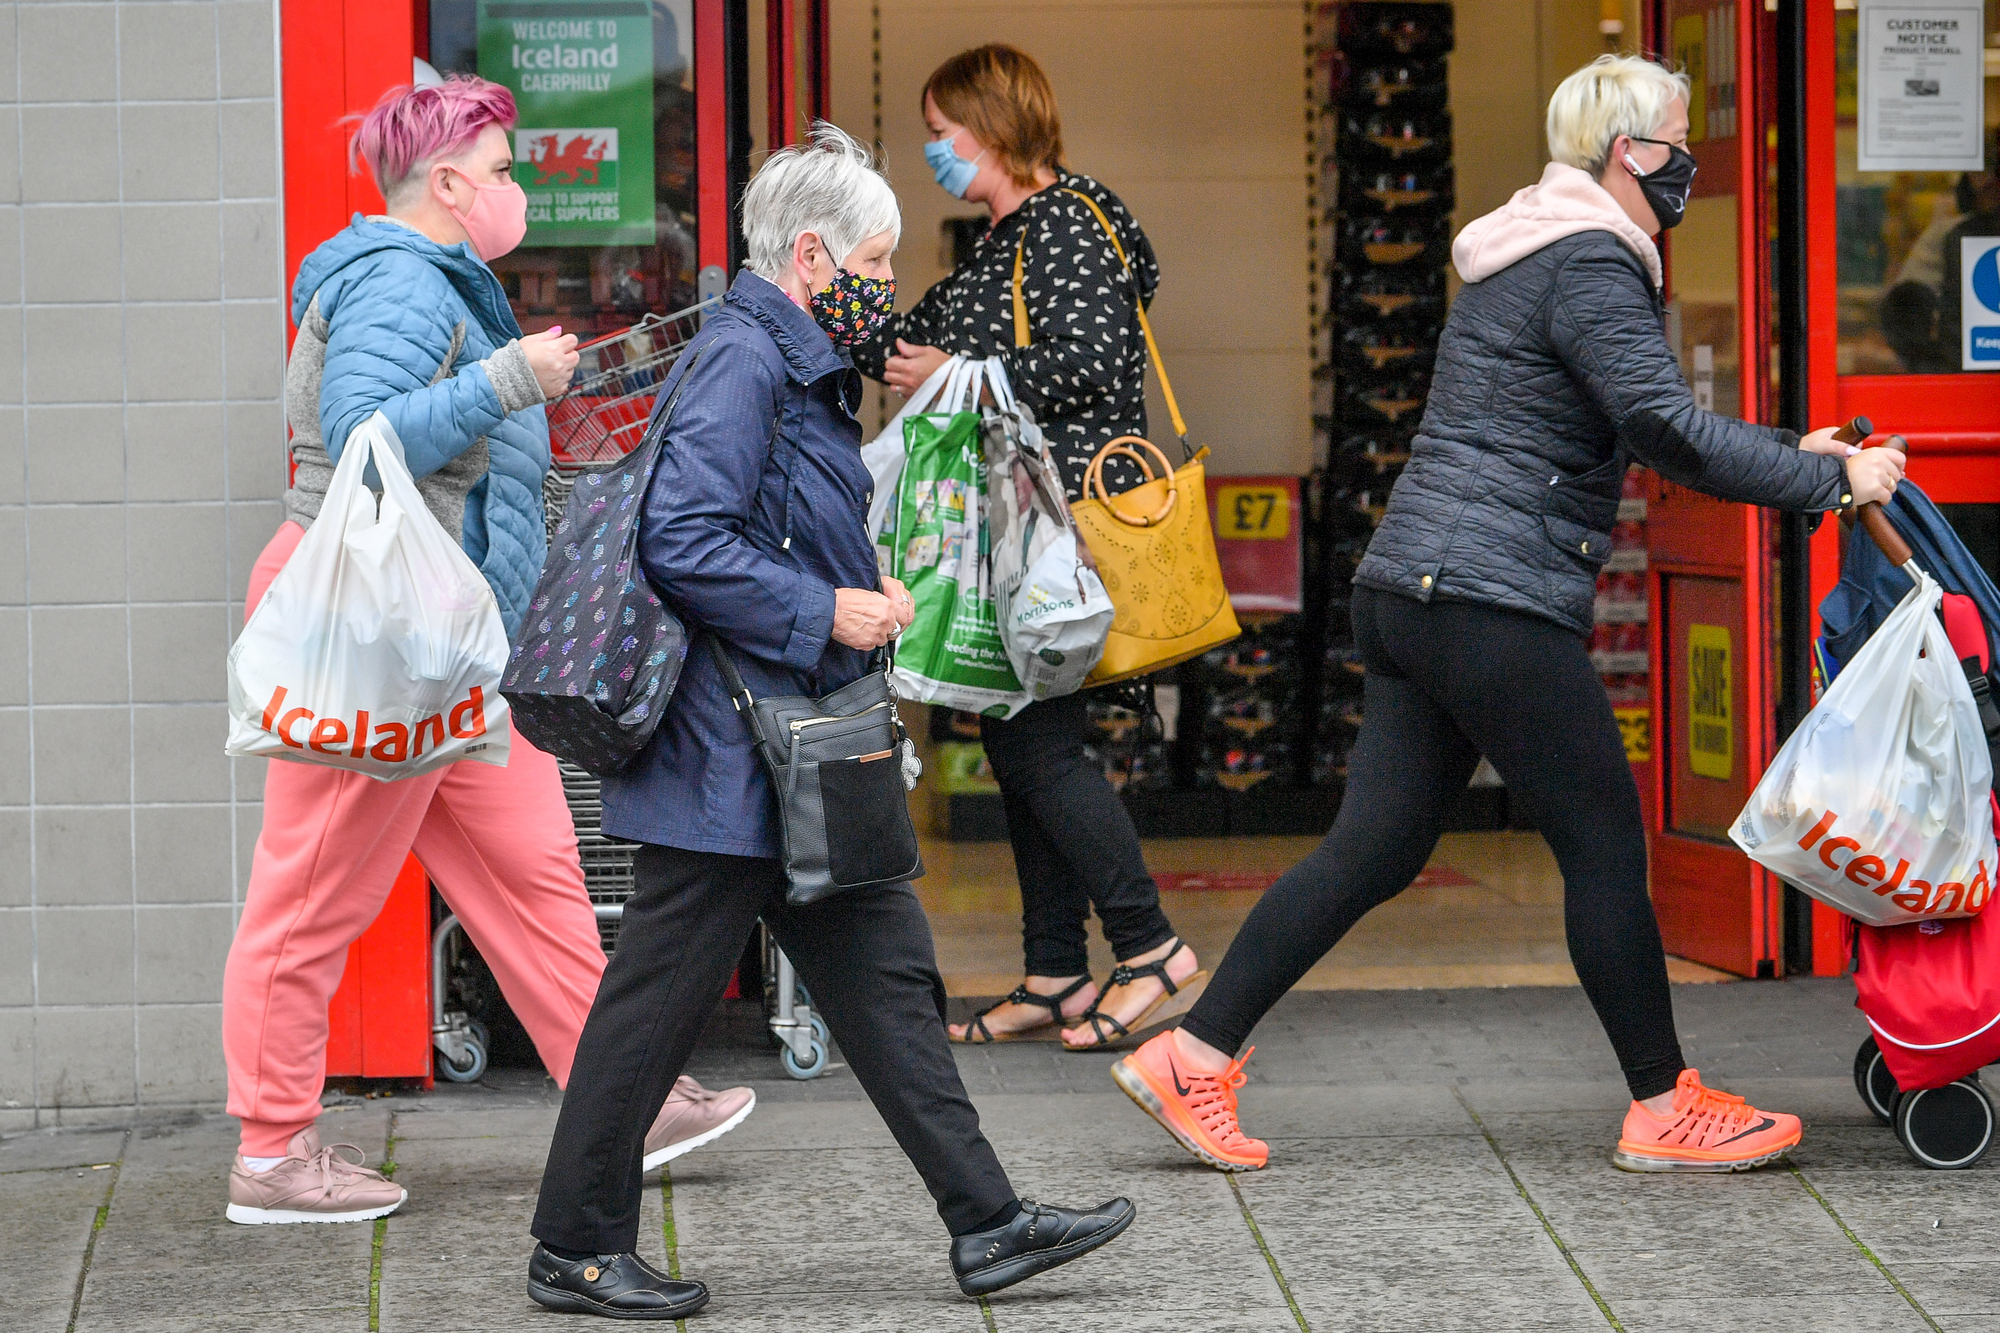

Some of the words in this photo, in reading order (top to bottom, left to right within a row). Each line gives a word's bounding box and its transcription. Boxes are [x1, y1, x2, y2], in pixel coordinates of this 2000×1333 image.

[513, 20, 593, 40] WELCOME
[598, 20, 617, 39] TO
[1887, 19, 1959, 30] CUSTOMER
[1897, 34, 1947, 44] NOTICE
[512, 43, 618, 69] Iceland
[521, 73, 610, 92] CAERPHILLY
[555, 192, 569, 206] TO
[570, 191, 619, 206] SUPPORT
[555, 206, 620, 222] SUPPLIERS
[1236, 494, 1275, 530] £7
[1017, 599, 1075, 625] Morrisons
[261, 685, 487, 762] Iceland
[1797, 809, 1990, 914] Iceland
